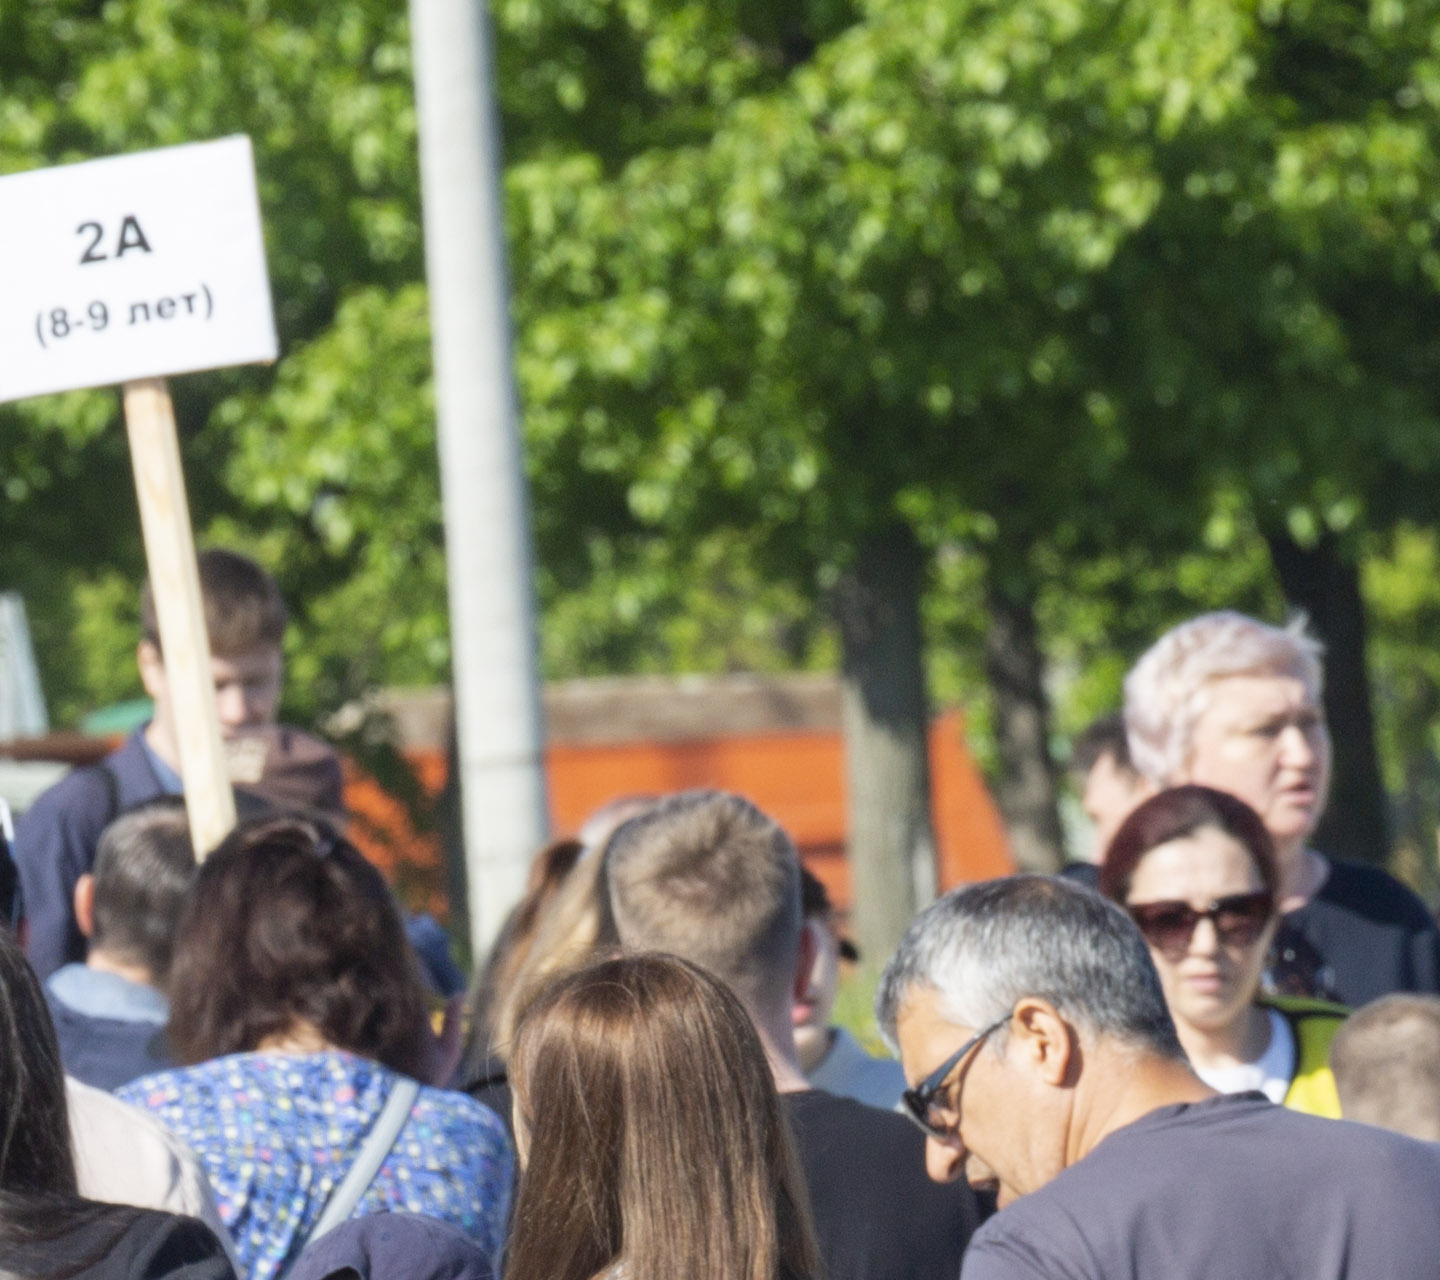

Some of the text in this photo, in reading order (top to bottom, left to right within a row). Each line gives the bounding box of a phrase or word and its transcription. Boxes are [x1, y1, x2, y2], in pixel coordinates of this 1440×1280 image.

[75, 213, 153, 265] 2А
[34, 282, 214, 349] (8-9 лет)
